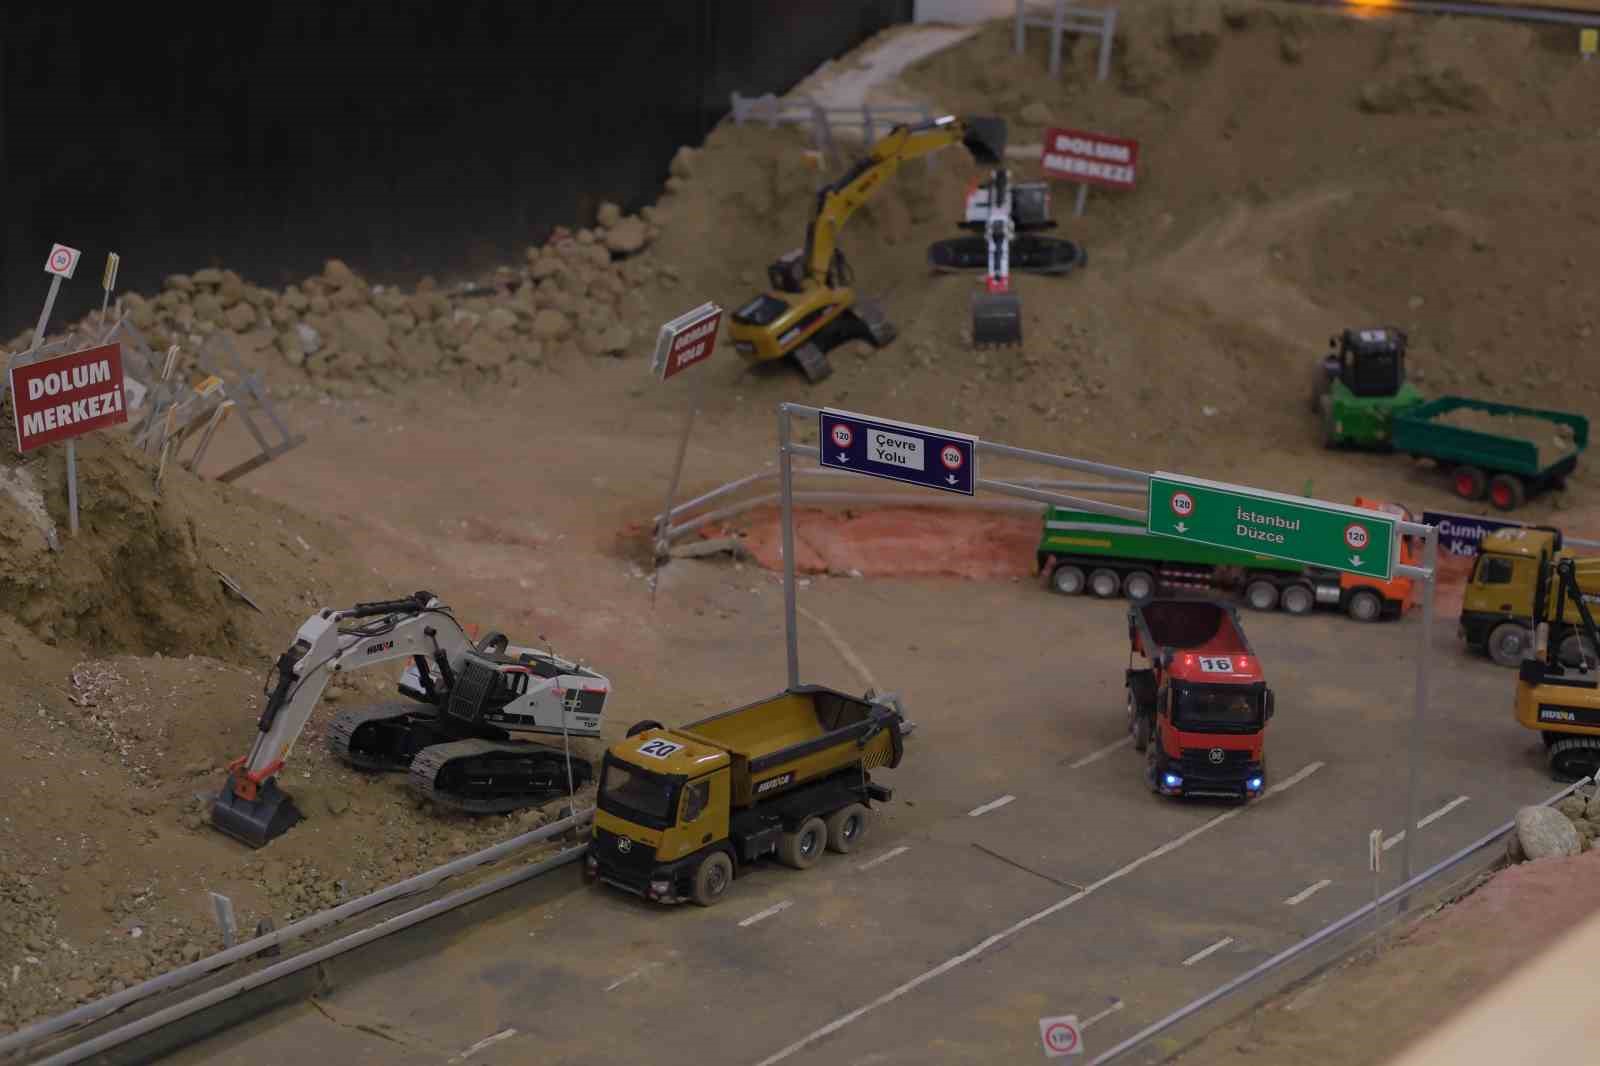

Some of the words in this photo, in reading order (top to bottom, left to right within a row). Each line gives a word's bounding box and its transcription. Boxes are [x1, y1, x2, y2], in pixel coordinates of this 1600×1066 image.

[28, 359, 111, 401] DOLUM
[23, 385, 124, 437] MERKEZİ
[834, 431, 849, 441] 120
[875, 434, 916, 452] Çevre
[876, 447, 906, 464] Yolu
[944, 452, 959, 464] 120
[1174, 498, 1190, 509] 120
[1236, 504, 1300, 531] İstanbul
[1236, 524, 1285, 544] Düzce
[1348, 531, 1365, 542] 120
[1438, 520, 1490, 539] Cumh
[1451, 540, 1478, 557] Ka
[1202, 659, 1230, 670] 16
[641, 741, 677, 756] 20
